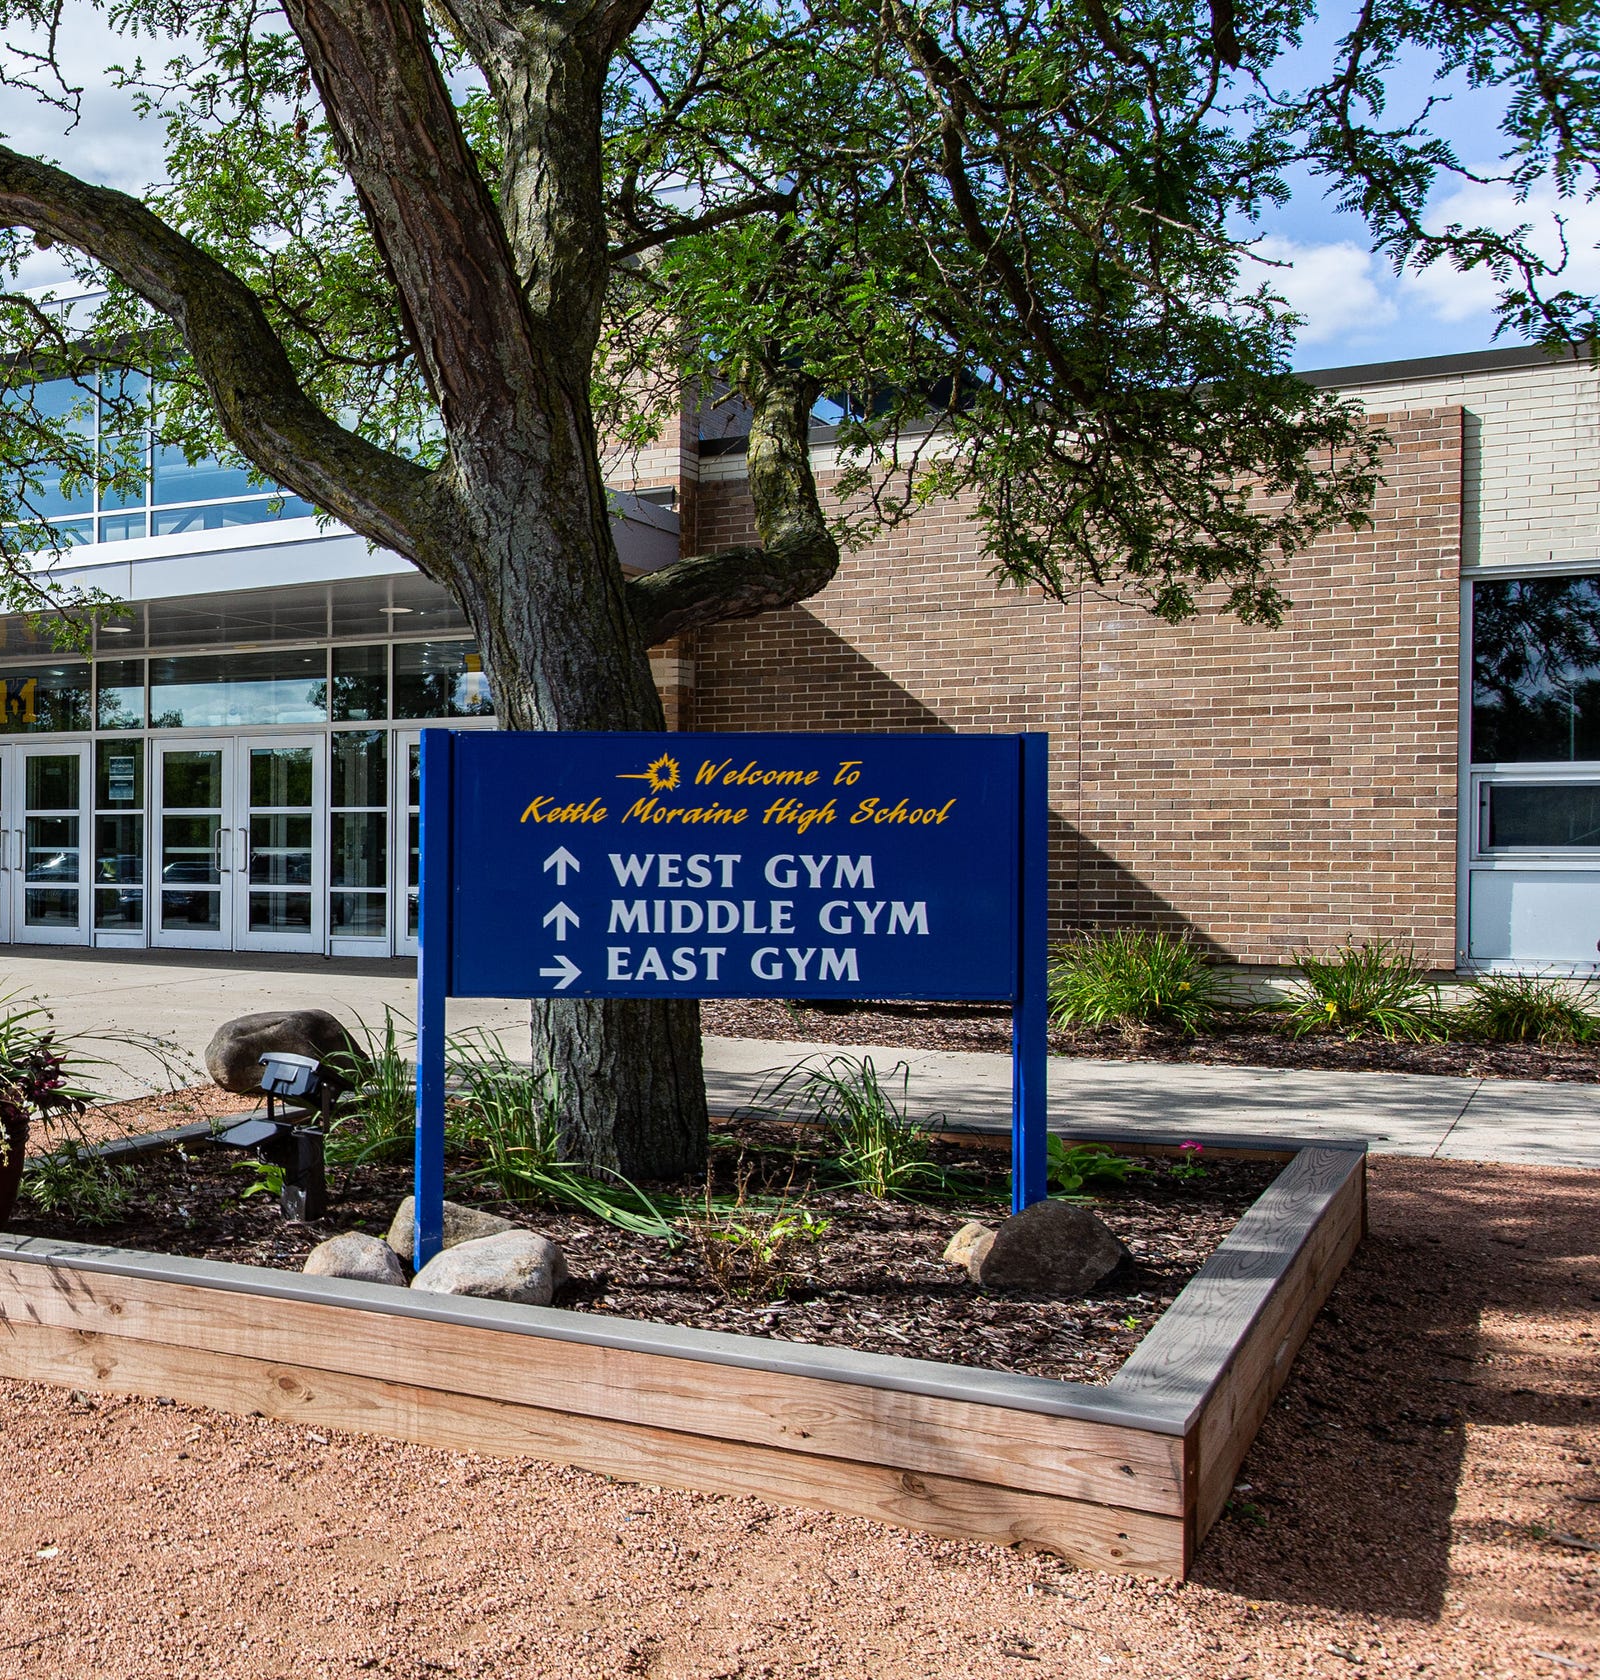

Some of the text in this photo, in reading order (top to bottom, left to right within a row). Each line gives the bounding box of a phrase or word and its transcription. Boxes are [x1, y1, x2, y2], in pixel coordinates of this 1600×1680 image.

[694, 758, 863, 785] Welcome To
[519, 795, 956, 834] Kettle Moraine High School
[608, 853, 875, 888] WEST GYM
[607, 899, 930, 935] MIDDLE GYM
[606, 946, 860, 981] EAST GYM
